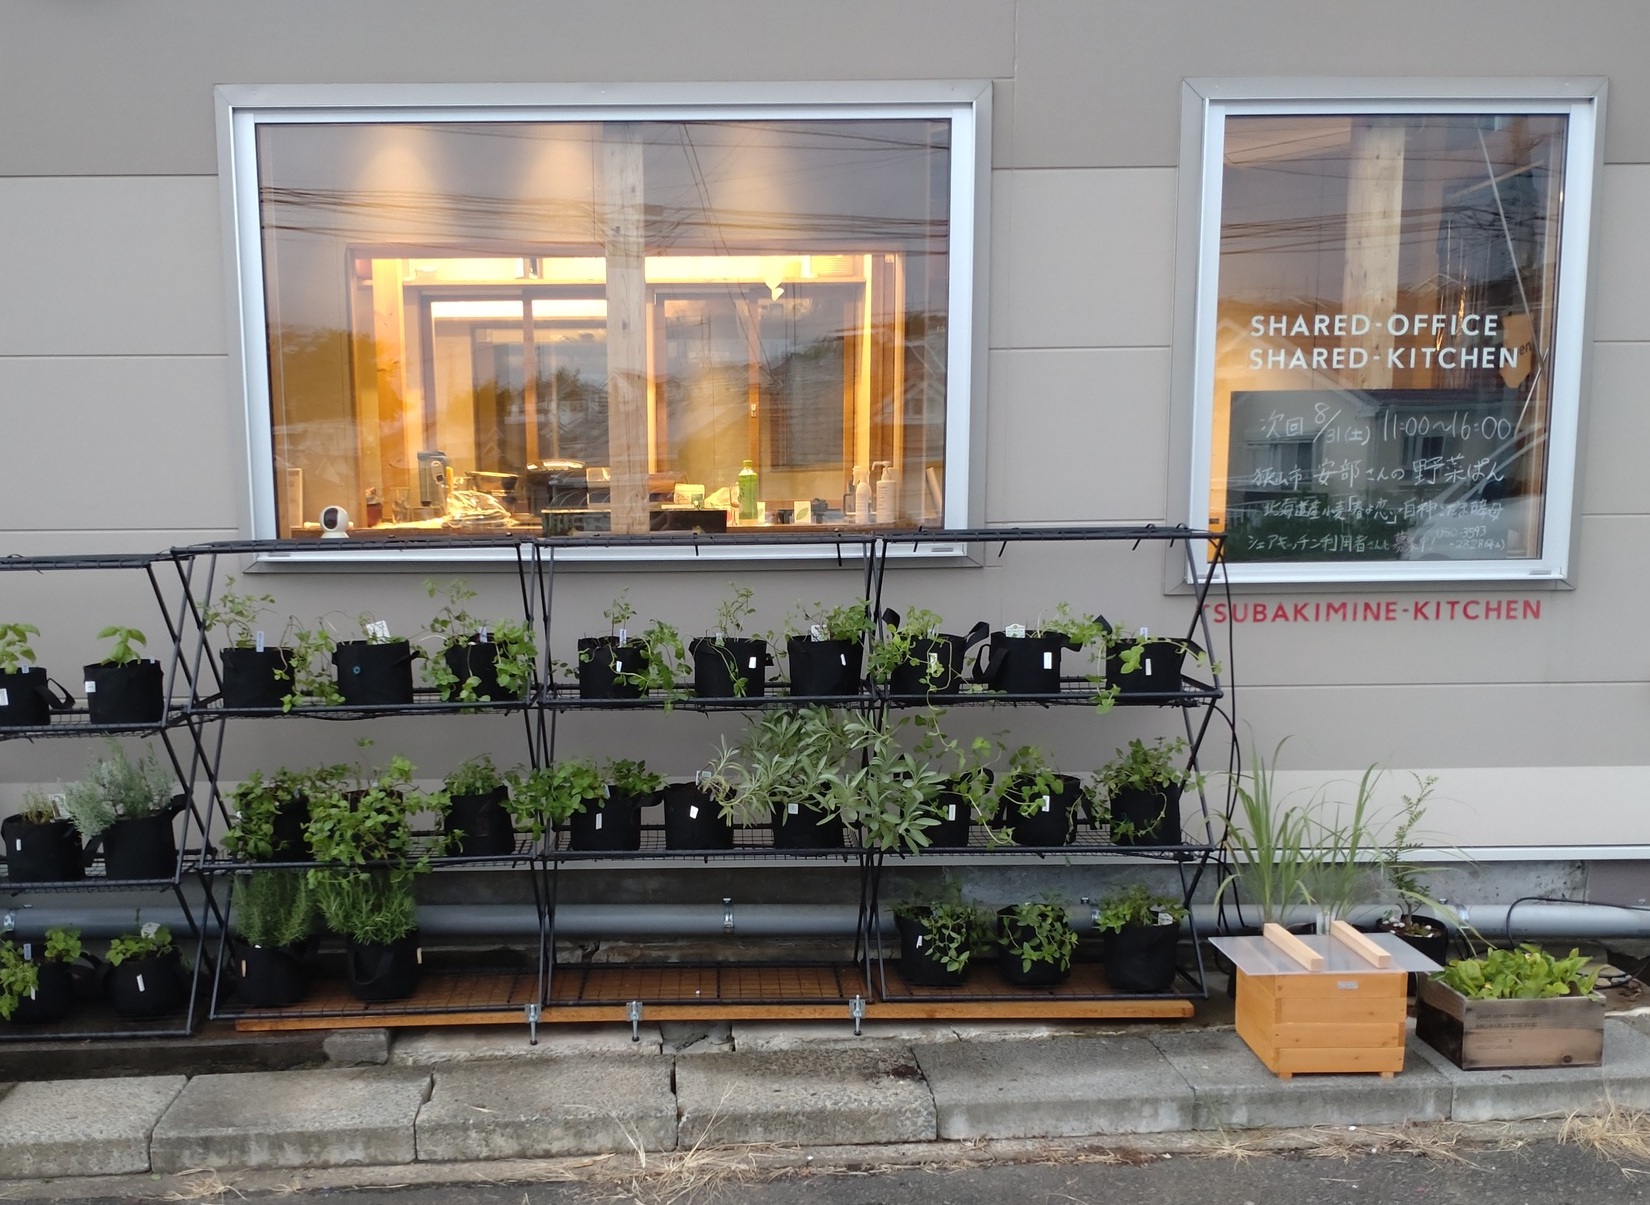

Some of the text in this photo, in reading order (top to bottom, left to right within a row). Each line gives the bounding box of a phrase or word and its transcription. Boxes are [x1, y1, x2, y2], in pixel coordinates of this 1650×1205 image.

[1249, 313, 1499, 338] SHARED-OFFICE
[1248, 346, 1519, 371] SHARED-KITCHEN
[1259, 409, 1304, 439] 次回
[1203, 600, 1542, 623] SUBAKIMINE-KITCHEN
